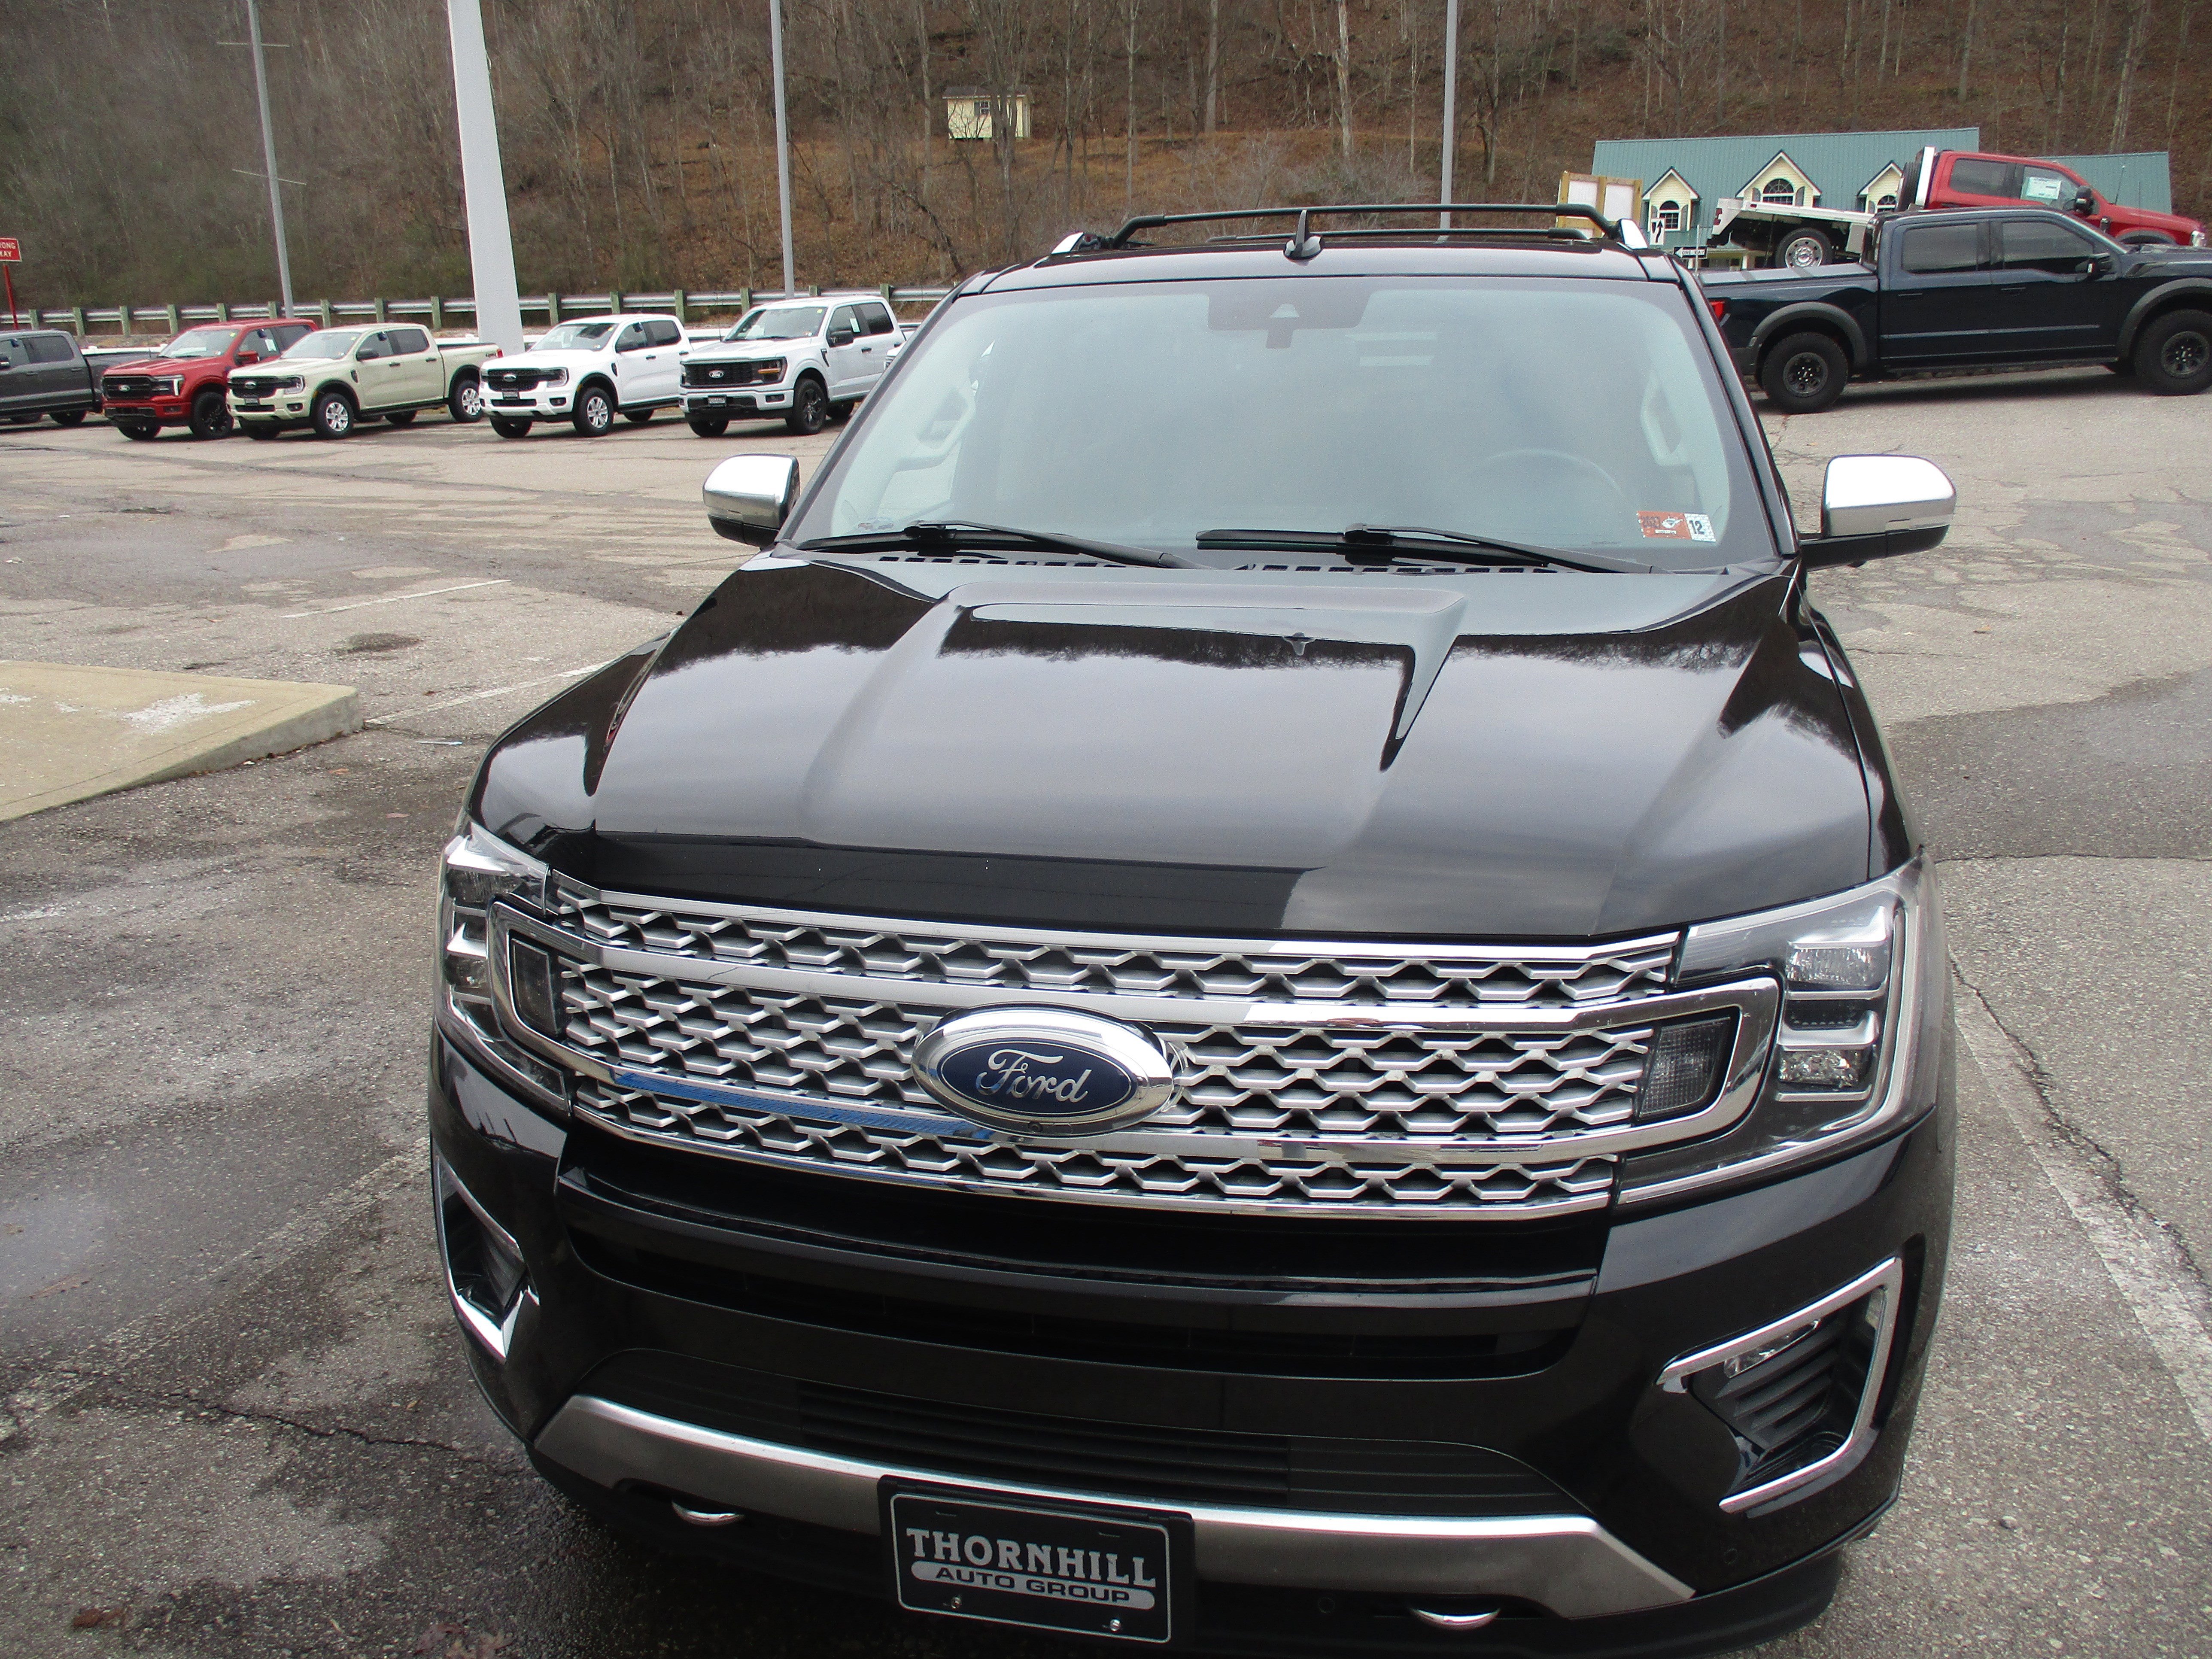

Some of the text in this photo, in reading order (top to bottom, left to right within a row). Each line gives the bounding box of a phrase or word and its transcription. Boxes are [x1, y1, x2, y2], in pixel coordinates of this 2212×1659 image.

[1689, 520, 1705, 535] 12
[975, 1049, 1092, 1103] Ford
[906, 1527, 1156, 1588] THORNHILL
[936, 1567, 1130, 1603] AUTO GROUP
